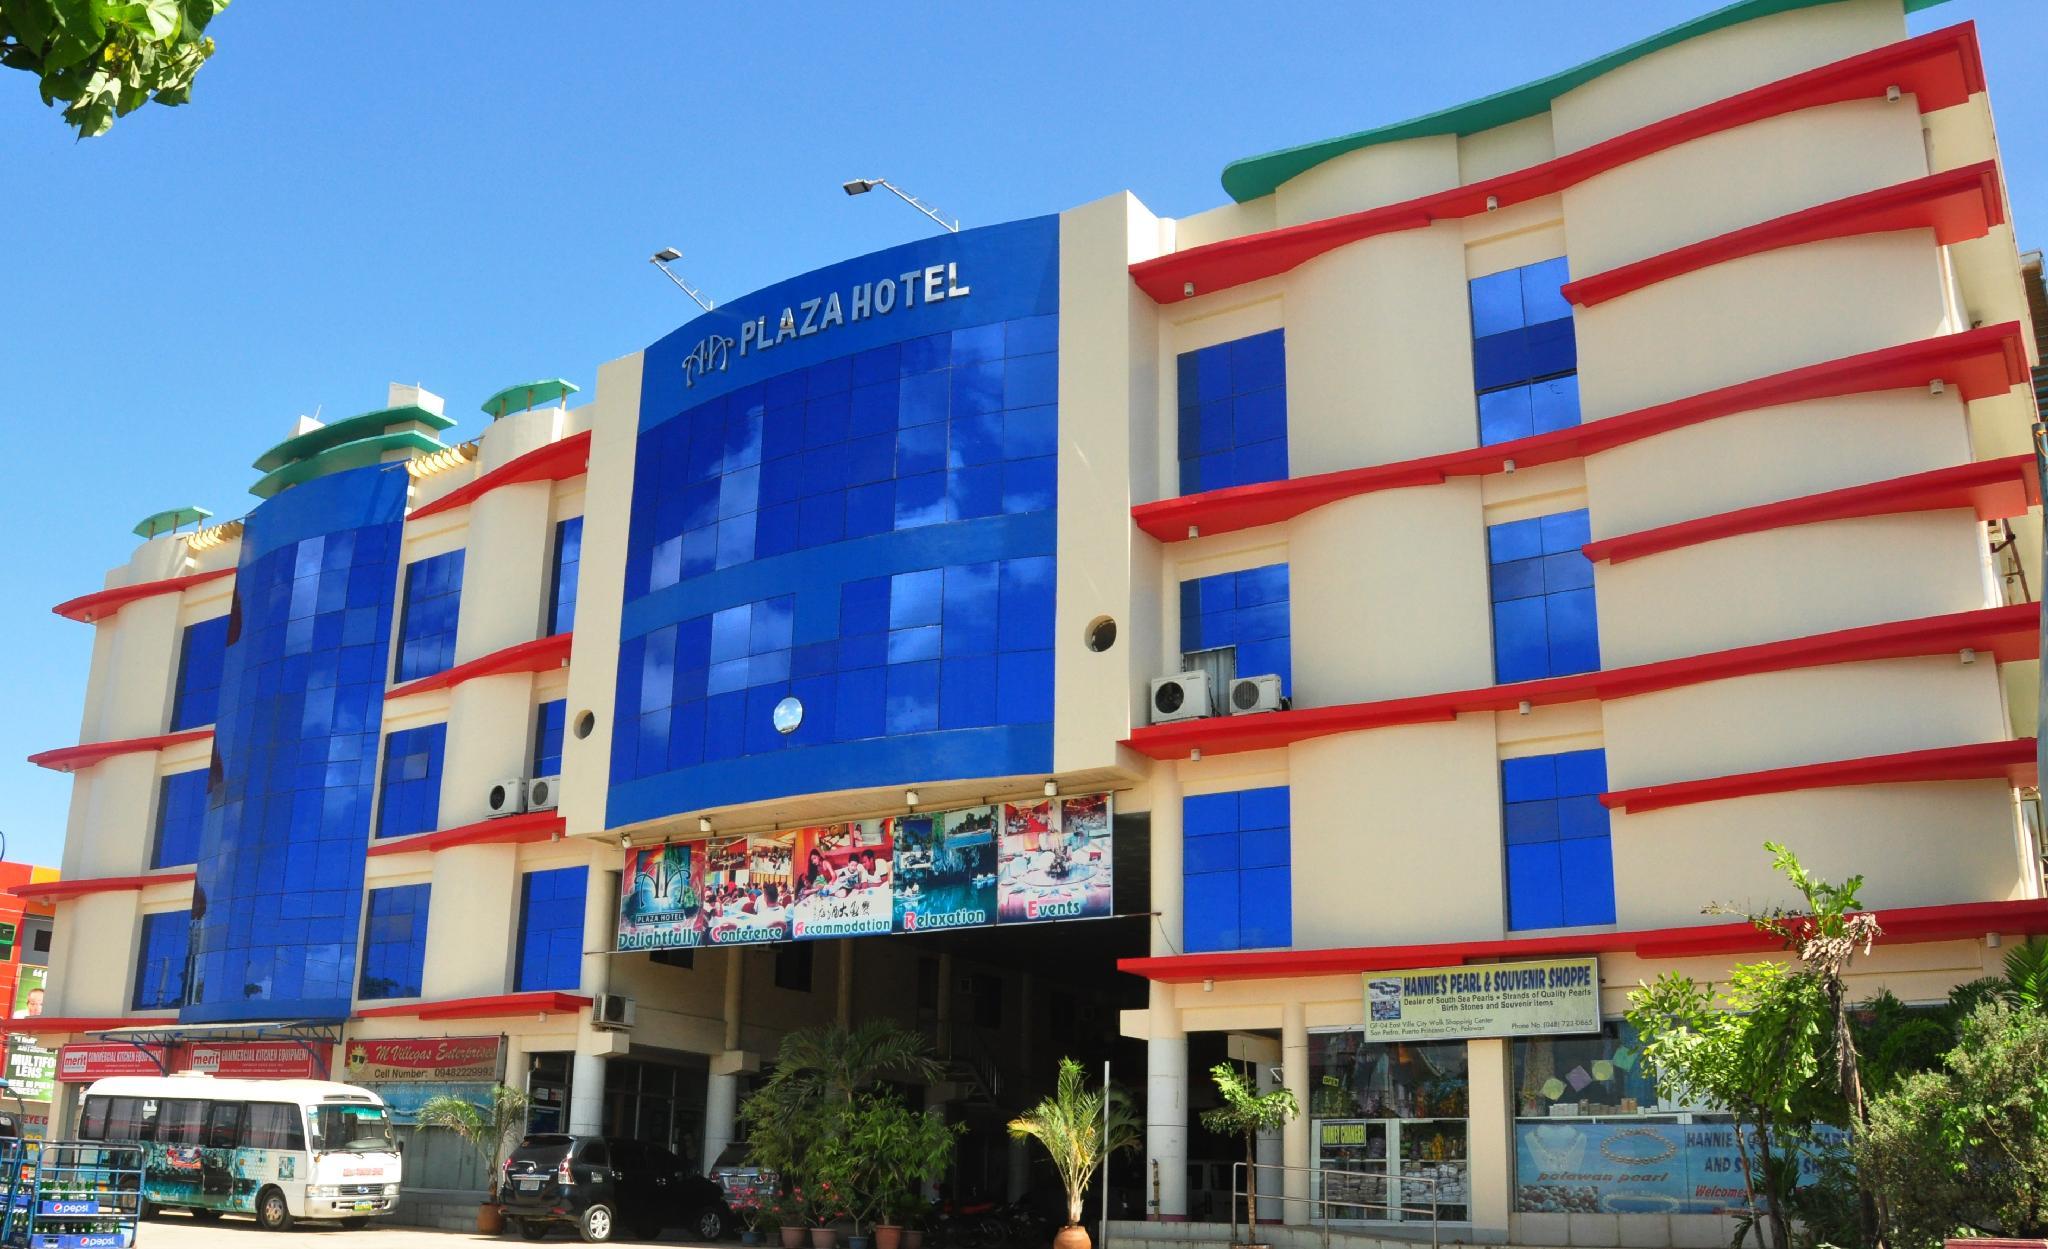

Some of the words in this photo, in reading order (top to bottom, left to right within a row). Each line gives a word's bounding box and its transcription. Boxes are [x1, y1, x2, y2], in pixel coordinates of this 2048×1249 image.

[740, 291, 844, 356] PLAZA
[852, 262, 970, 321] HOTEL
[619, 928, 701, 949] Delightfully
[712, 926, 782, 943] Conference
[795, 919, 890, 937] Accommodation
[904, 908, 984, 930] Relaxation
[1028, 899, 1080, 918] Events
[637, 915, 659, 923] PLAZA
[660, 913, 683, 921] HOTEL
[1403, 974, 1448, 997] HANNIE'S
[1450, 972, 1482, 994] PEARL
[1484, 971, 1492, 993] &
[1494, 967, 1546, 992] SOUVENIR
[1549, 965, 1591, 989] SHOPPE
[1403, 997, 1426, 1006] Dealer
[1426, 997, 1434, 1005] of
[1436, 996, 1456, 1004] South
[1457, 995, 1471, 1003] Sea
[1472, 994, 1494, 1002] Pearls
[1502, 991, 1530, 1000] Strands
[1532, 991, 1539, 999] of
[1541, 989, 1566, 999] Quality
[1568, 988, 1591, 997] Pearls
[1441, 1004, 1459, 1012] Birth
[1460, 1003, 1484, 1011] Stones
[1486, 1002, 1499, 1010] and
[1500, 1000, 1532, 1009] Souvenir
[64, 1054, 87, 1066] merit
[194, 1053, 219, 1065] merit
[221, 1049, 255, 1062] COMMERCIAL
[255, 1049, 278, 1062] KITCHEN
[279, 1048, 309, 1062] EQUIPMENT
[391, 1045, 433, 1065] Villegas
[16, 1065, 42, 1079] LENS
[374, 1069, 392, 1078] Cell
[392, 1068, 429, 1078] Number:
[1704, 1157, 1731, 1173] AND
[1536, 1171, 1613, 1183] palawan
[1617, 1171, 1670, 1184] pearl
[63, 1203, 89, 1214] pepsi
[89, 1237, 116, 1248] pepsi
